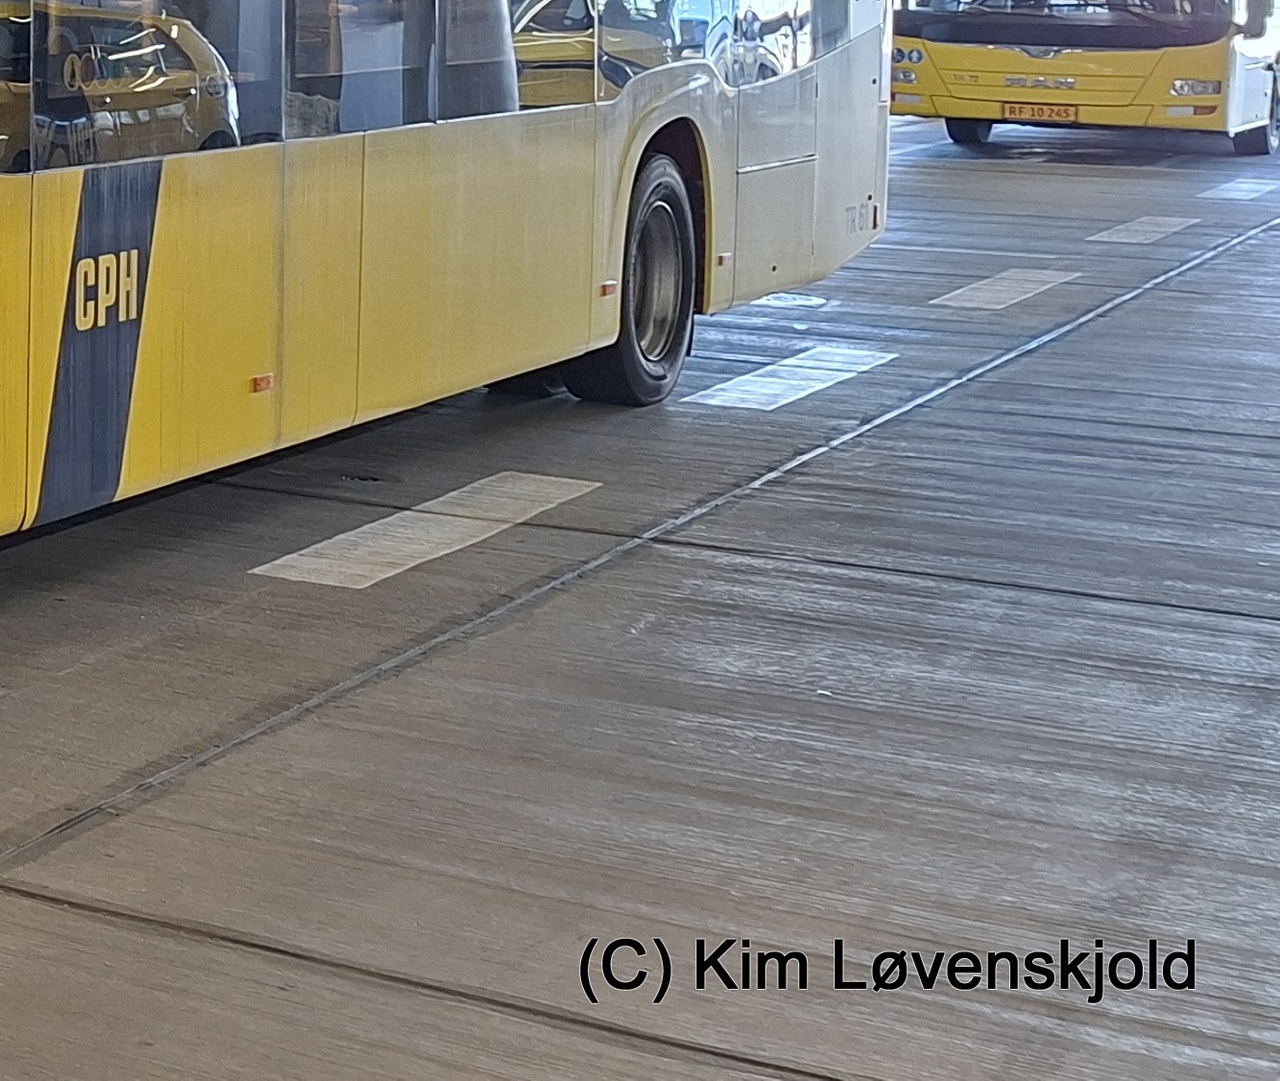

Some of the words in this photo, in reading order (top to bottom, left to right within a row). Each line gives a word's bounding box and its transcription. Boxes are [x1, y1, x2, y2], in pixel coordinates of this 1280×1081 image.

[1008, 107, 1025, 117] RF
[1029, 107, 1044, 118] 10
[1046, 107, 1071, 119] 245
[75, 248, 139, 331] CPH
